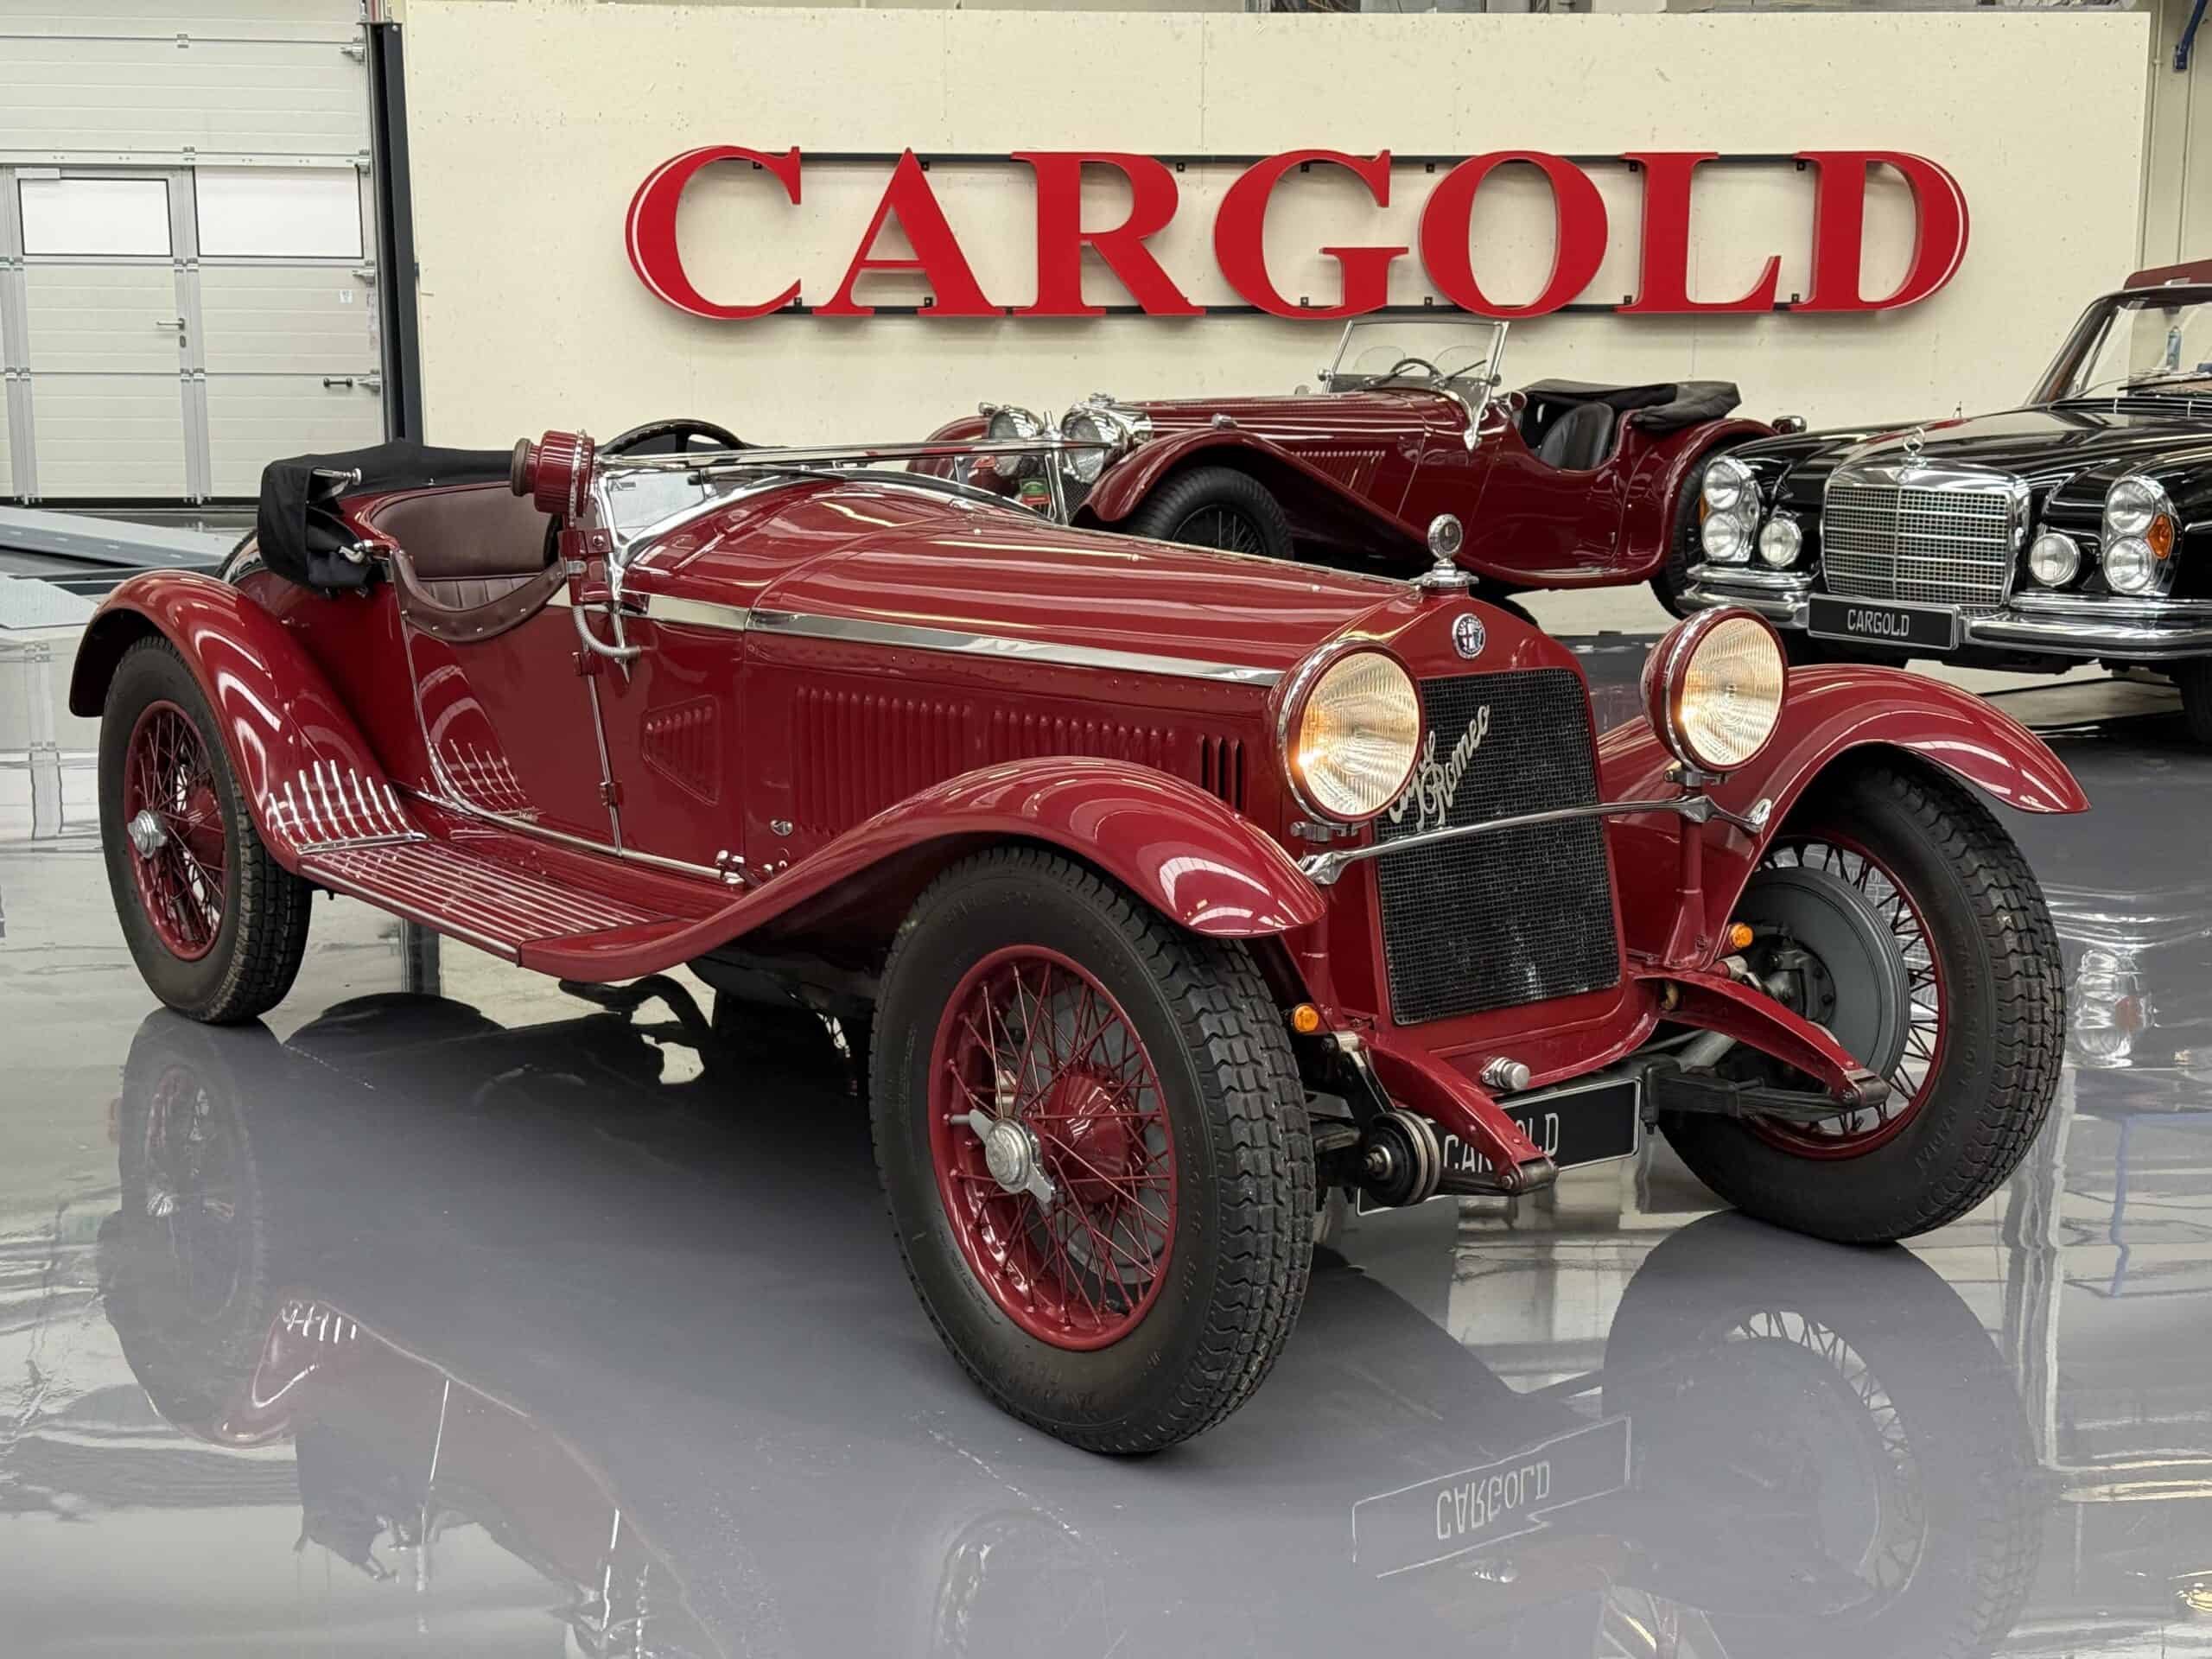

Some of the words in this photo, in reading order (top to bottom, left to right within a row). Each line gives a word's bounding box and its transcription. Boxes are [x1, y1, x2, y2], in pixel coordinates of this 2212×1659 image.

[626, 144, 1970, 321] CARGOLD
[1847, 608, 1910, 637] CARGOLD
[1421, 704, 1490, 826] Romeo
[1443, 1112, 1559, 1173] CALD
